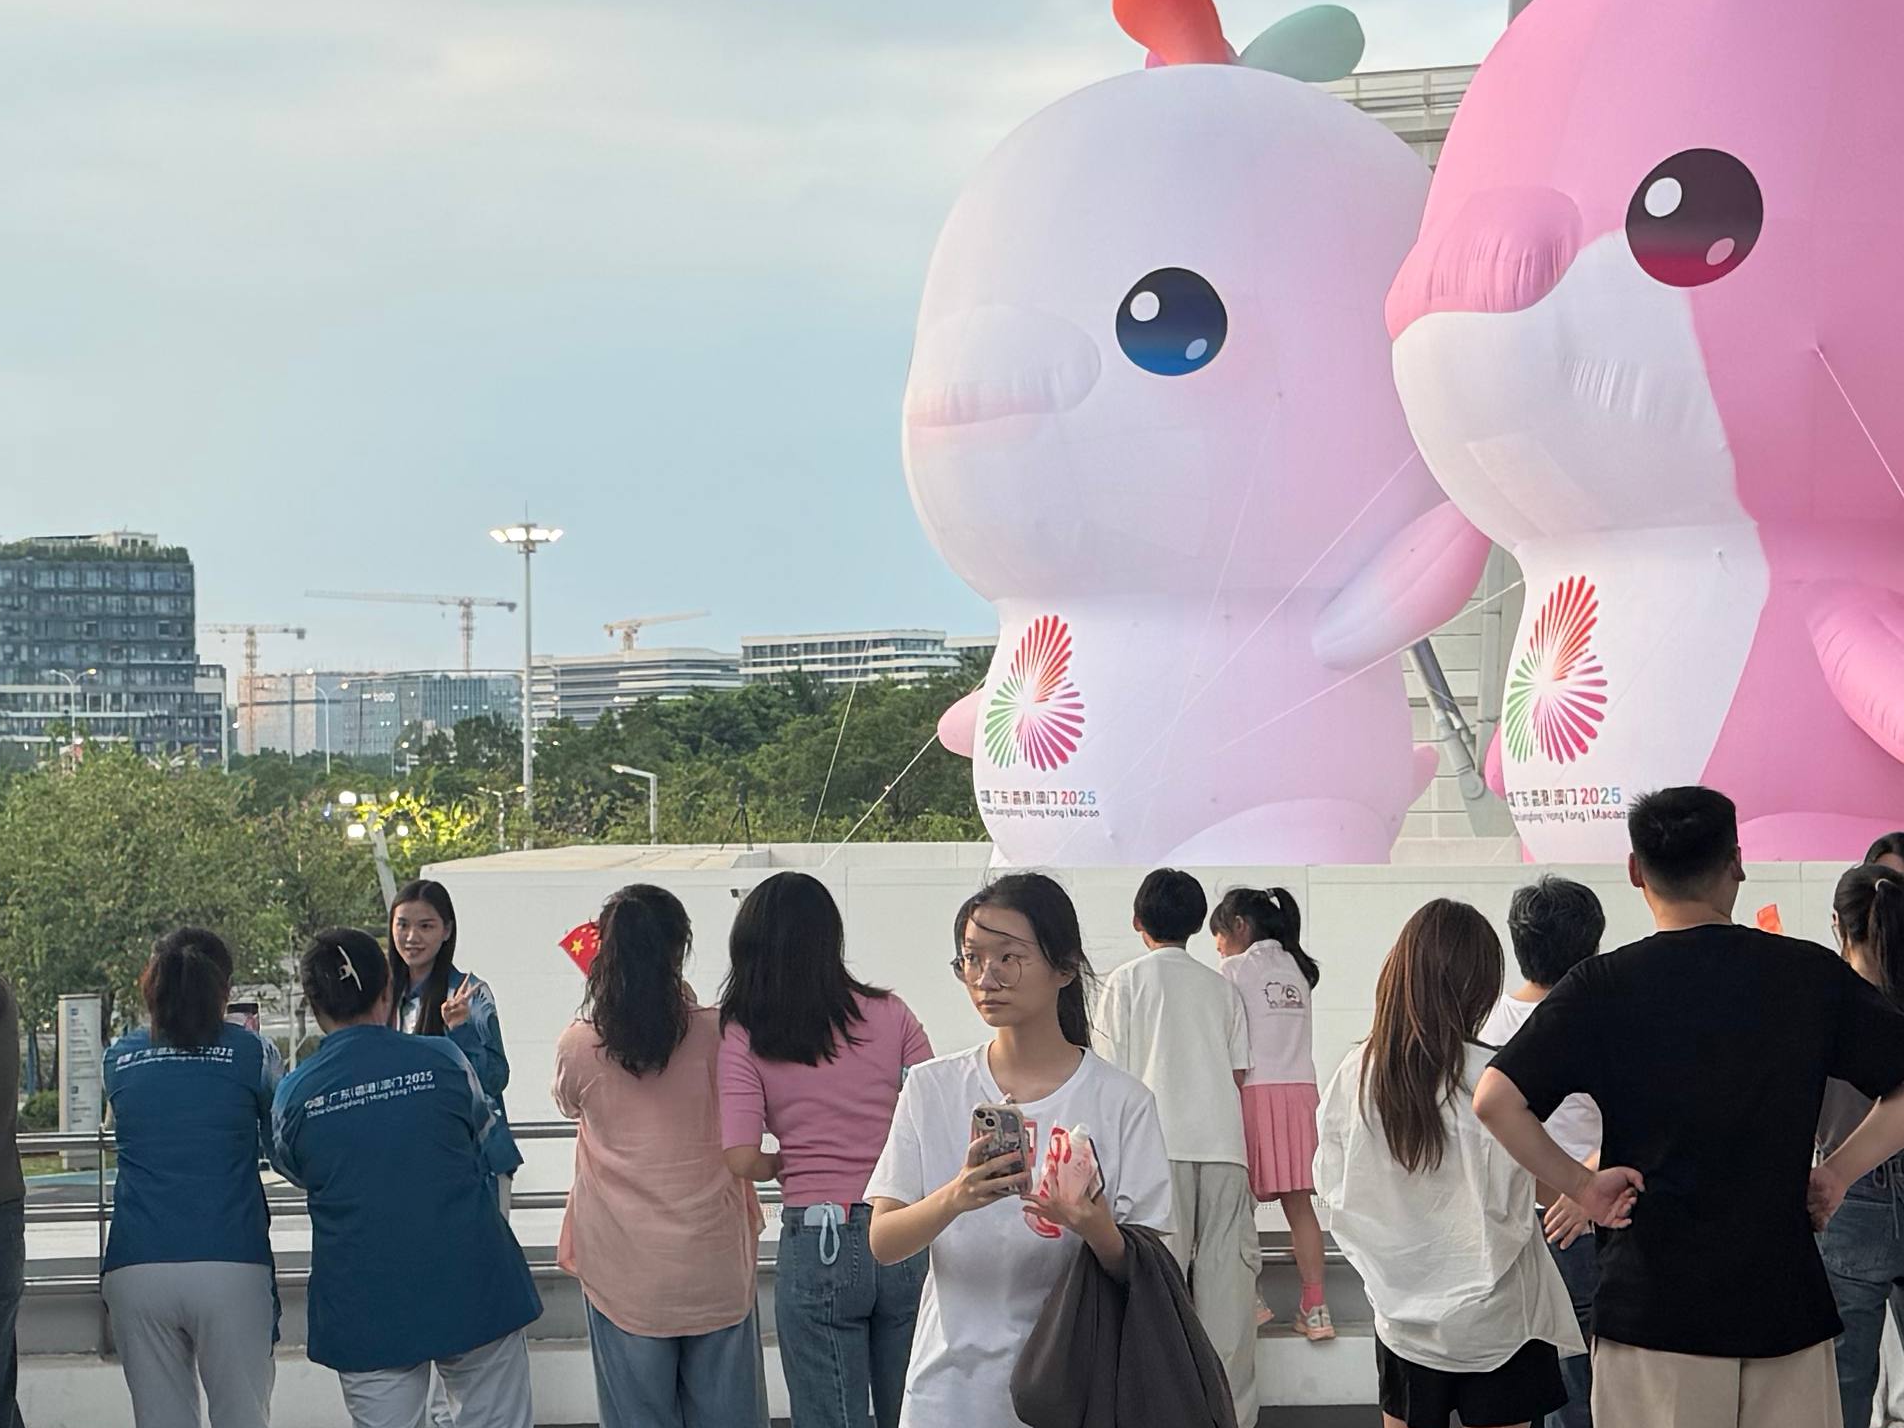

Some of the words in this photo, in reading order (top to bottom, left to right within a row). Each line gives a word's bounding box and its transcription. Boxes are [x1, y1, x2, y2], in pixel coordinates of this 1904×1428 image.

[1060, 790, 1097, 805] 2025
[1580, 786, 1622, 805] 2025
[405, 1070, 434, 1086] 2025
